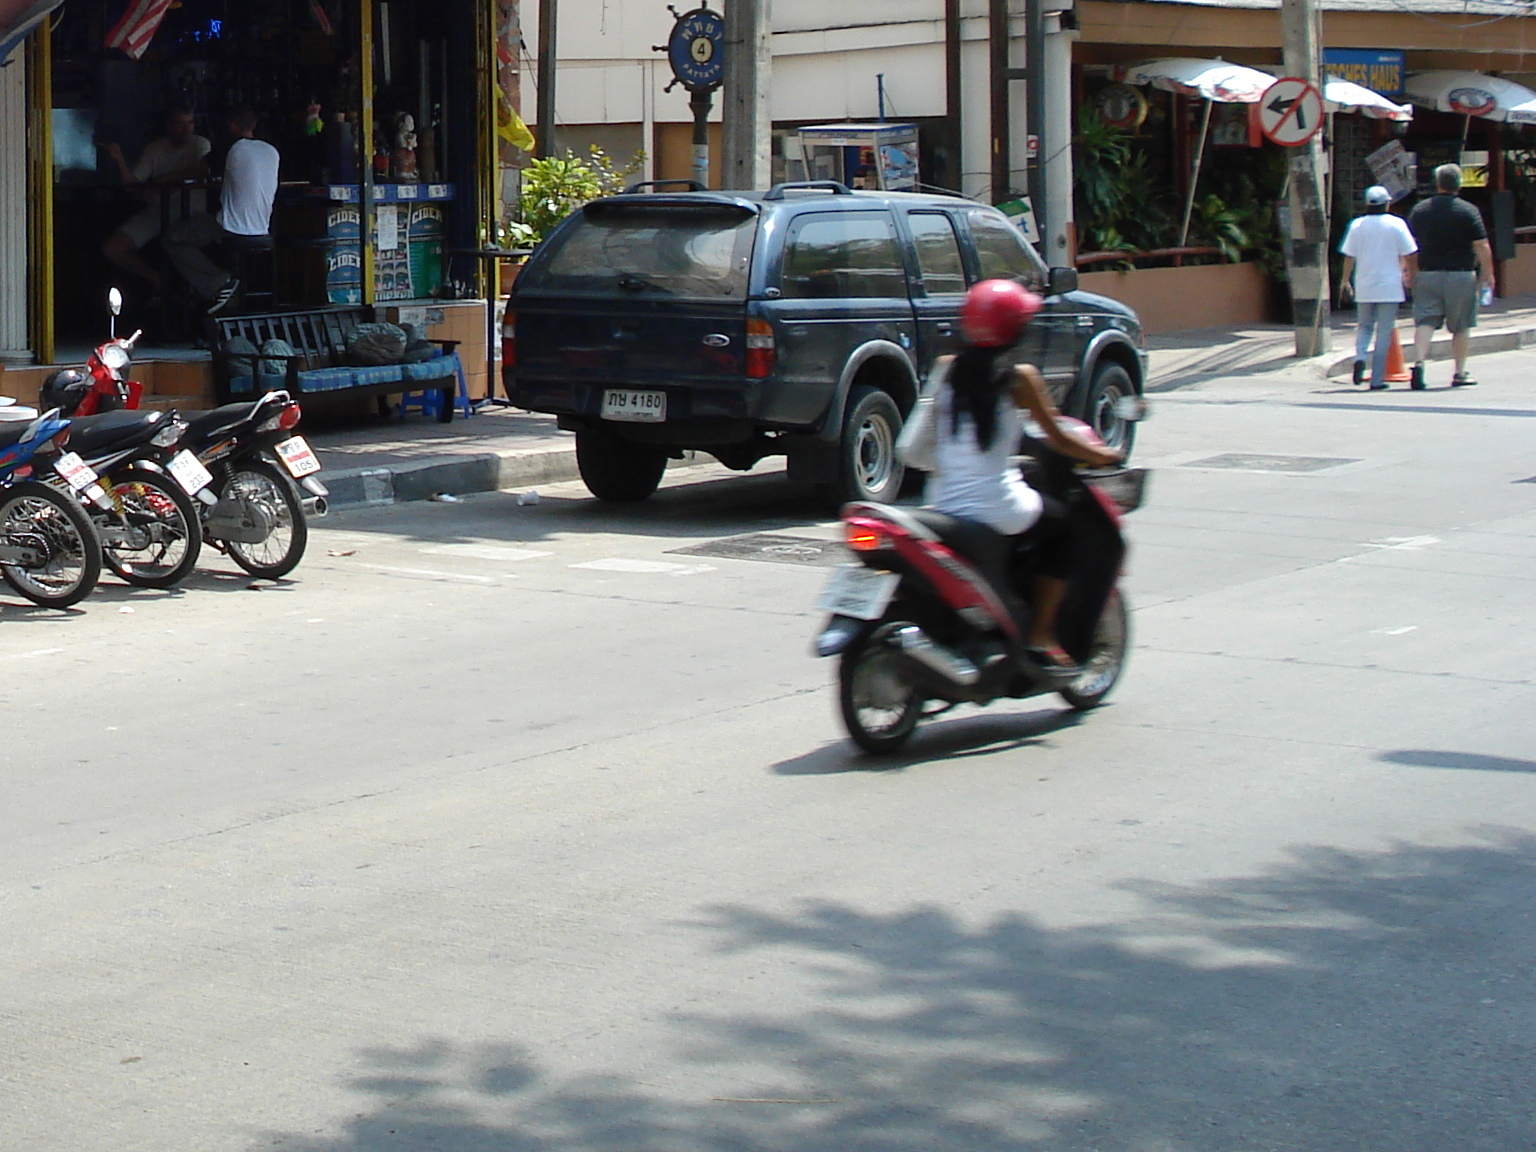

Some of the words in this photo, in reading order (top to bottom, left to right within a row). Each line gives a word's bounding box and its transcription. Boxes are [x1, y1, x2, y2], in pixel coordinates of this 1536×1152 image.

[697, 43, 706, 56] 4
[682, 63, 721, 78] PATTAYA
[1370, 65, 1400, 91] HAUS
